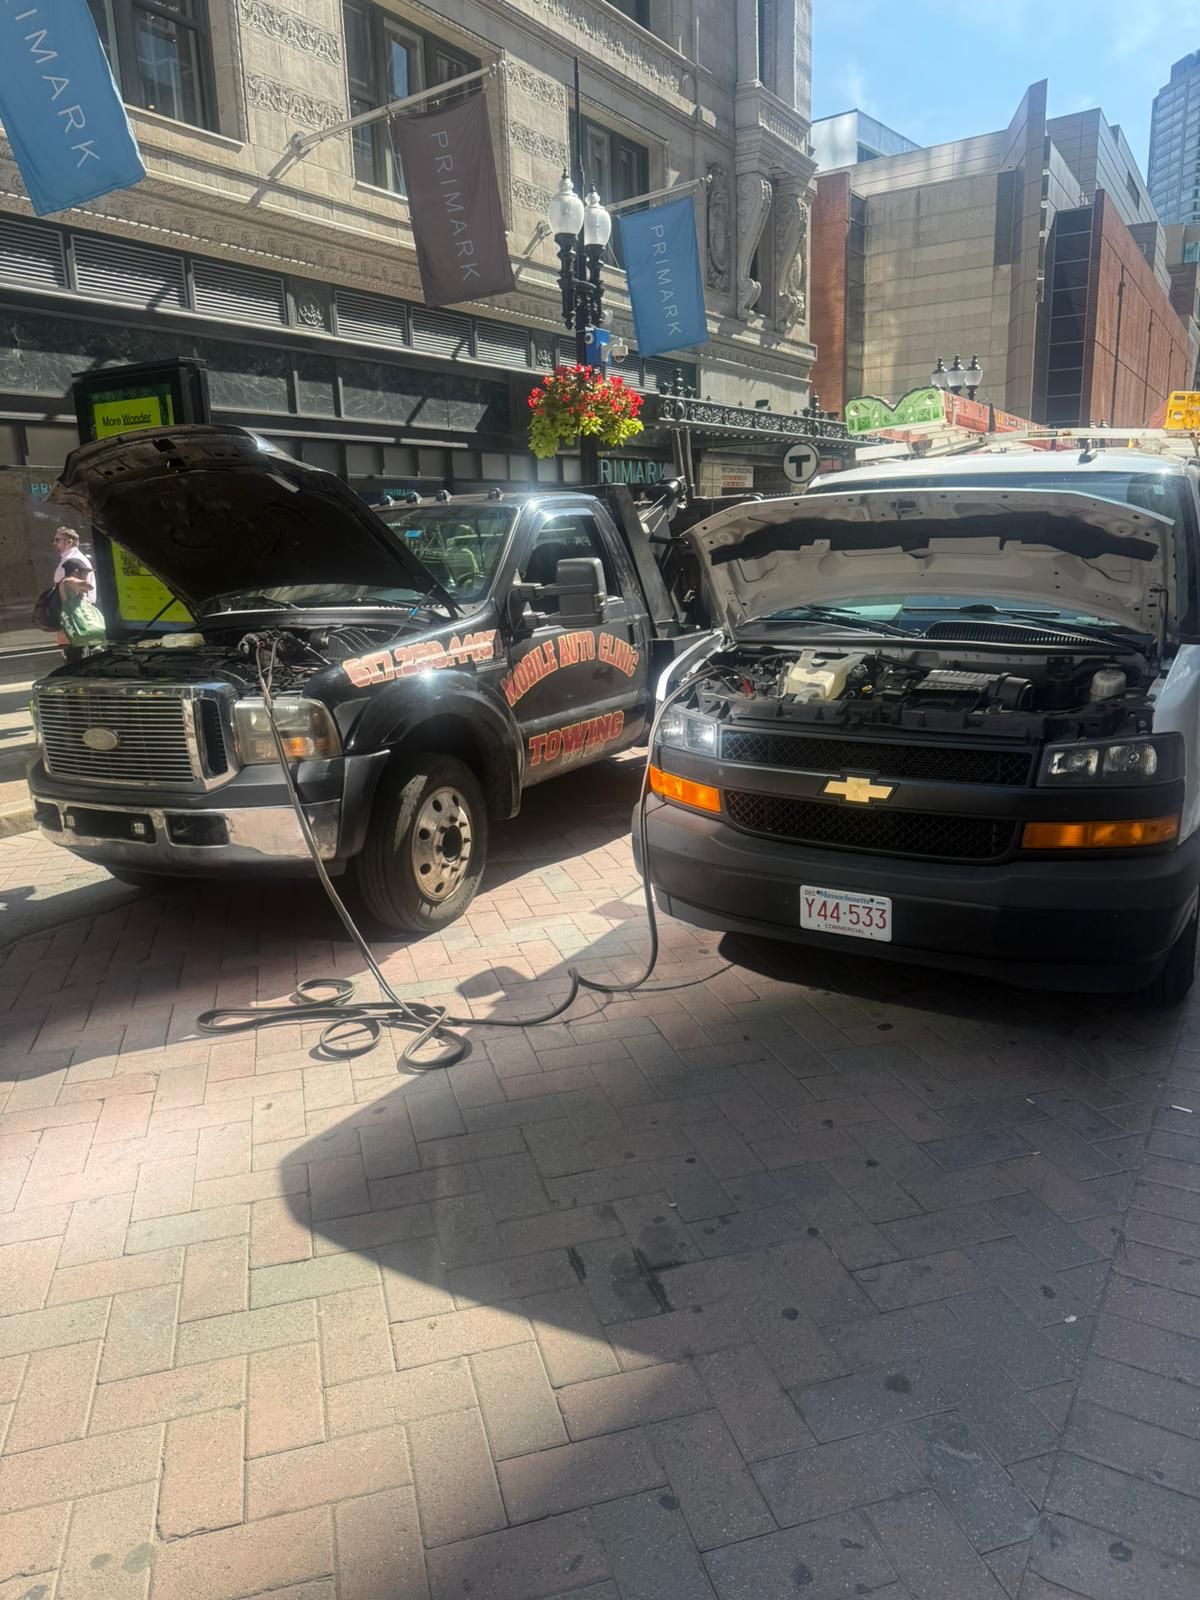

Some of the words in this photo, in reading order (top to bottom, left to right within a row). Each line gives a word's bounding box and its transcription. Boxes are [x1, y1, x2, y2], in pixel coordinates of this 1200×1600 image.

[6, 0, 100, 168] IMARK
[431, 130, 481, 281] PRIMARK
[650, 224, 682, 336] PRIMARK
[102, 416, 121, 427] More
[121, 413, 152, 425] Wonder
[600, 459, 668, 484] RIMARK
[788, 454, 811, 478] T
[500, 640, 559, 708] MOBILE
[558, 630, 596, 668] AUTO
[598, 632, 640, 678] CLINIC
[528, 710, 625, 767] TOWING
[819, 890, 871, 905] Massachusetts
[825, 923, 866, 935] COMMERCIAL
